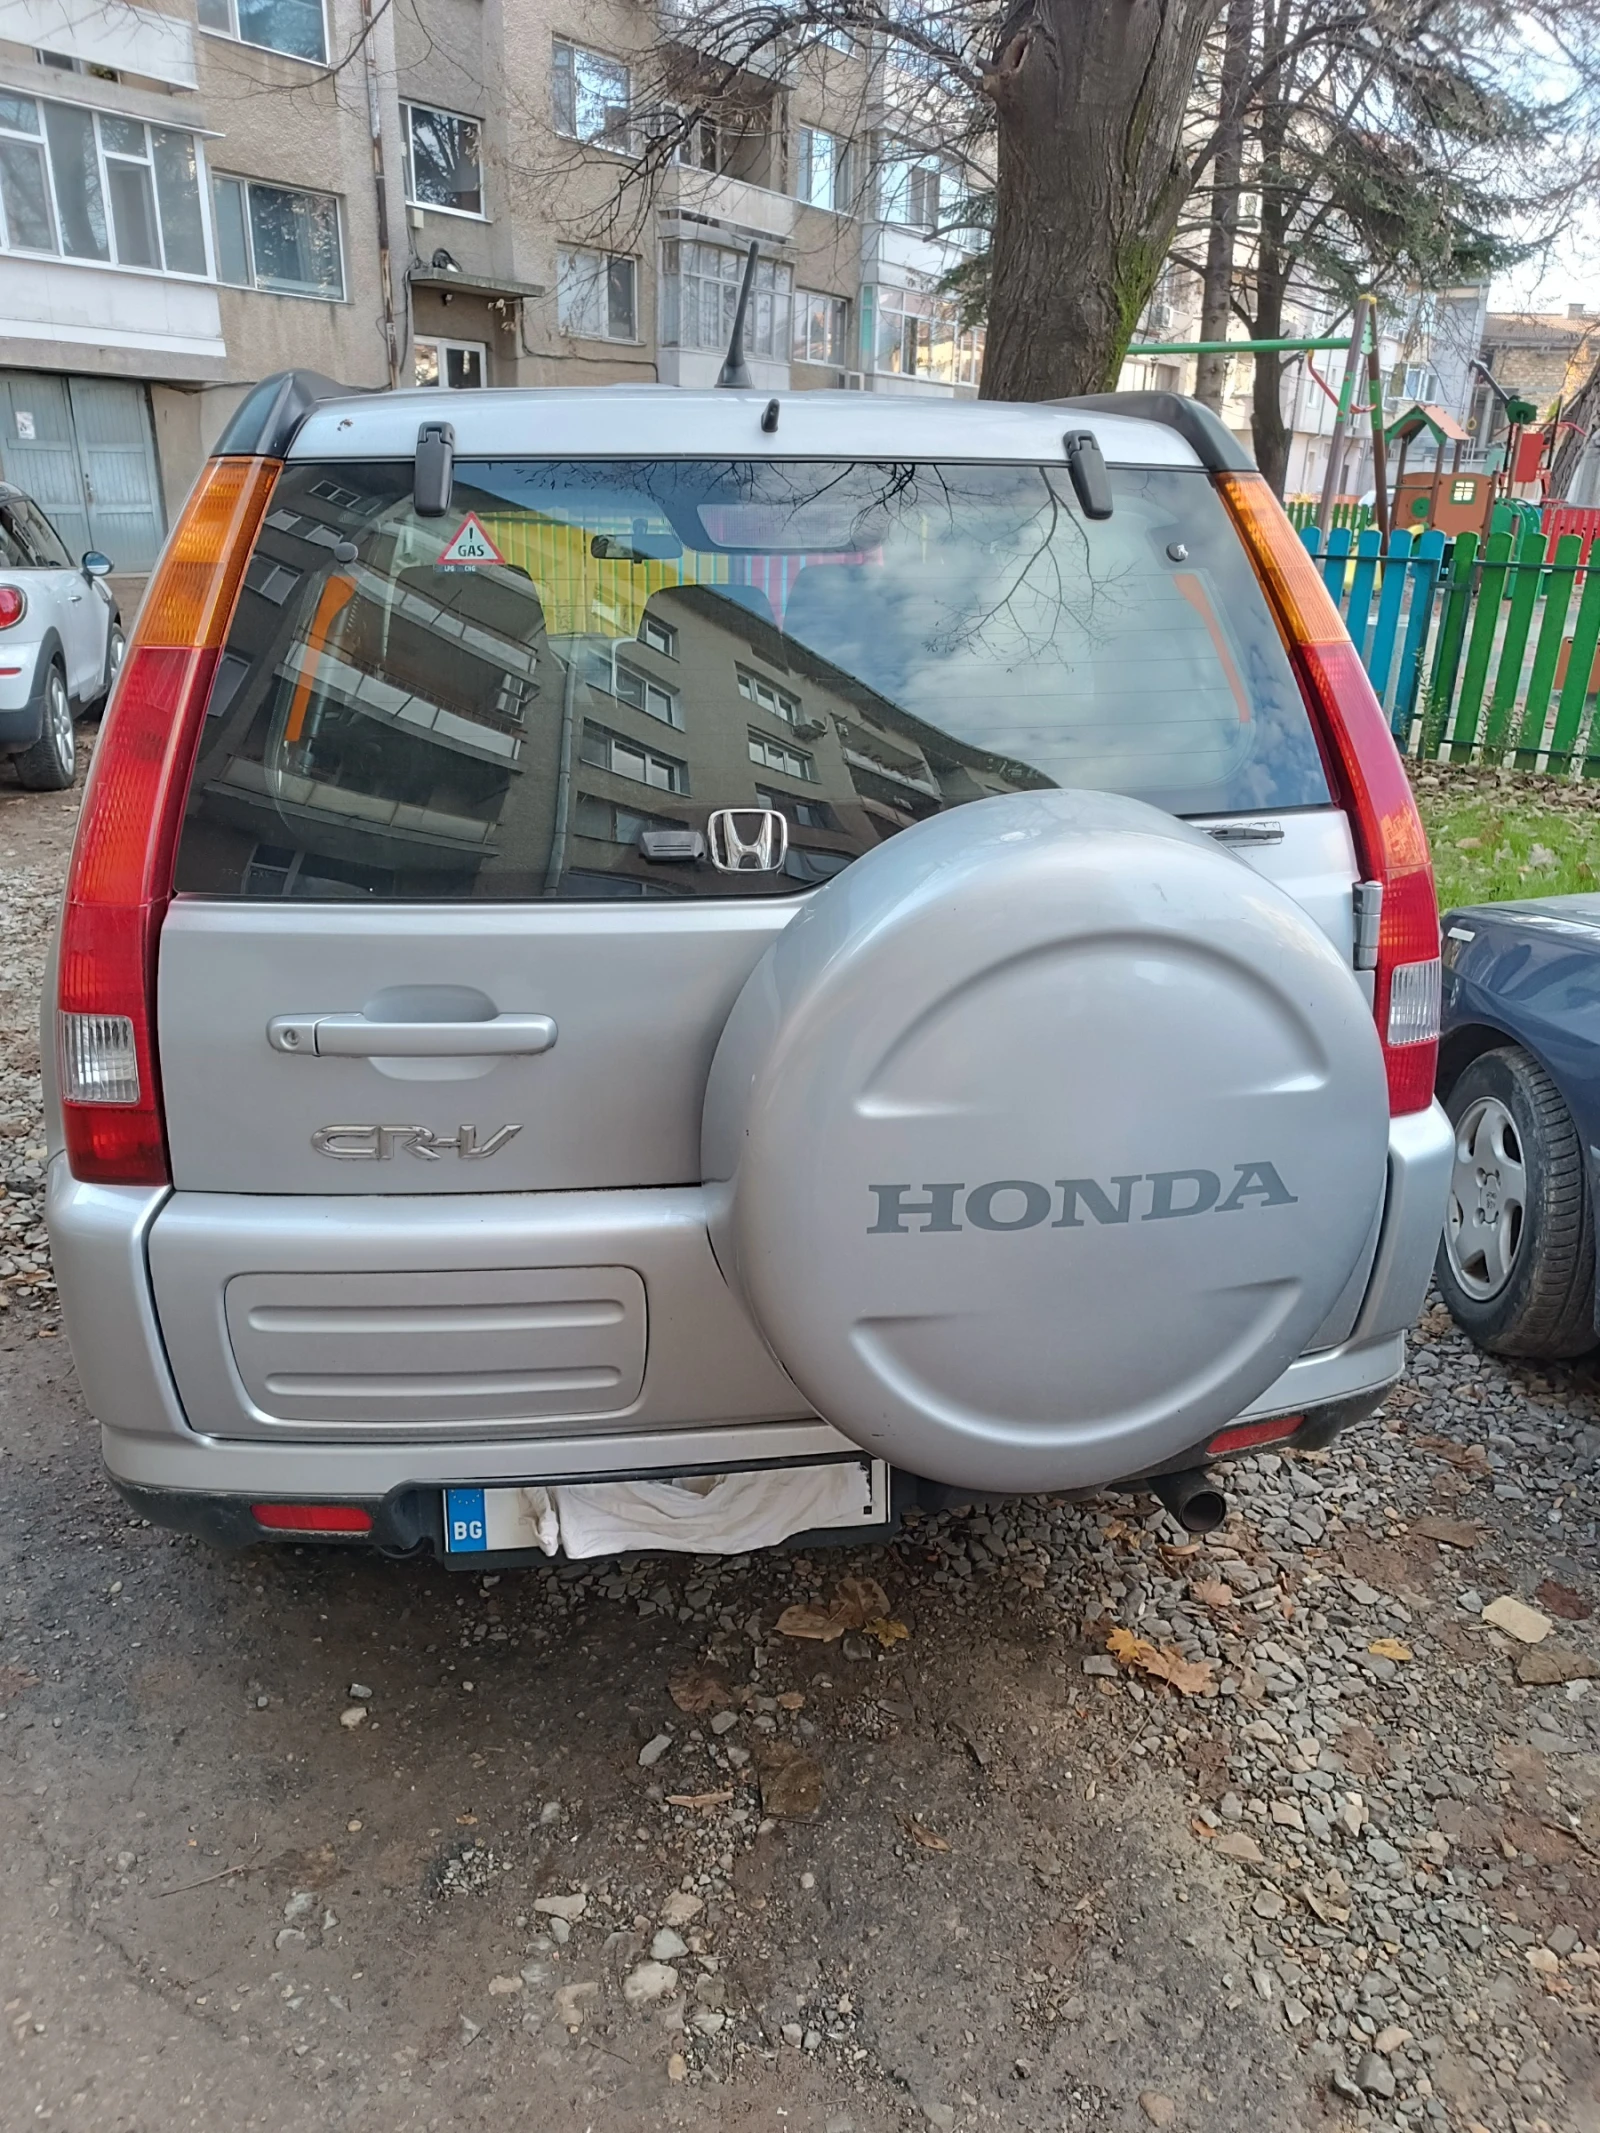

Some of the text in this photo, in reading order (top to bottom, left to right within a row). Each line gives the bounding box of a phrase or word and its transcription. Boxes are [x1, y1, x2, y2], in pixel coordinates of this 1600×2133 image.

[457, 545, 485, 557] GAS
[310, 1124, 524, 1161] CR-V
[866, 1160, 1299, 1234] HONDA
[453, 1520, 483, 1541] BG
